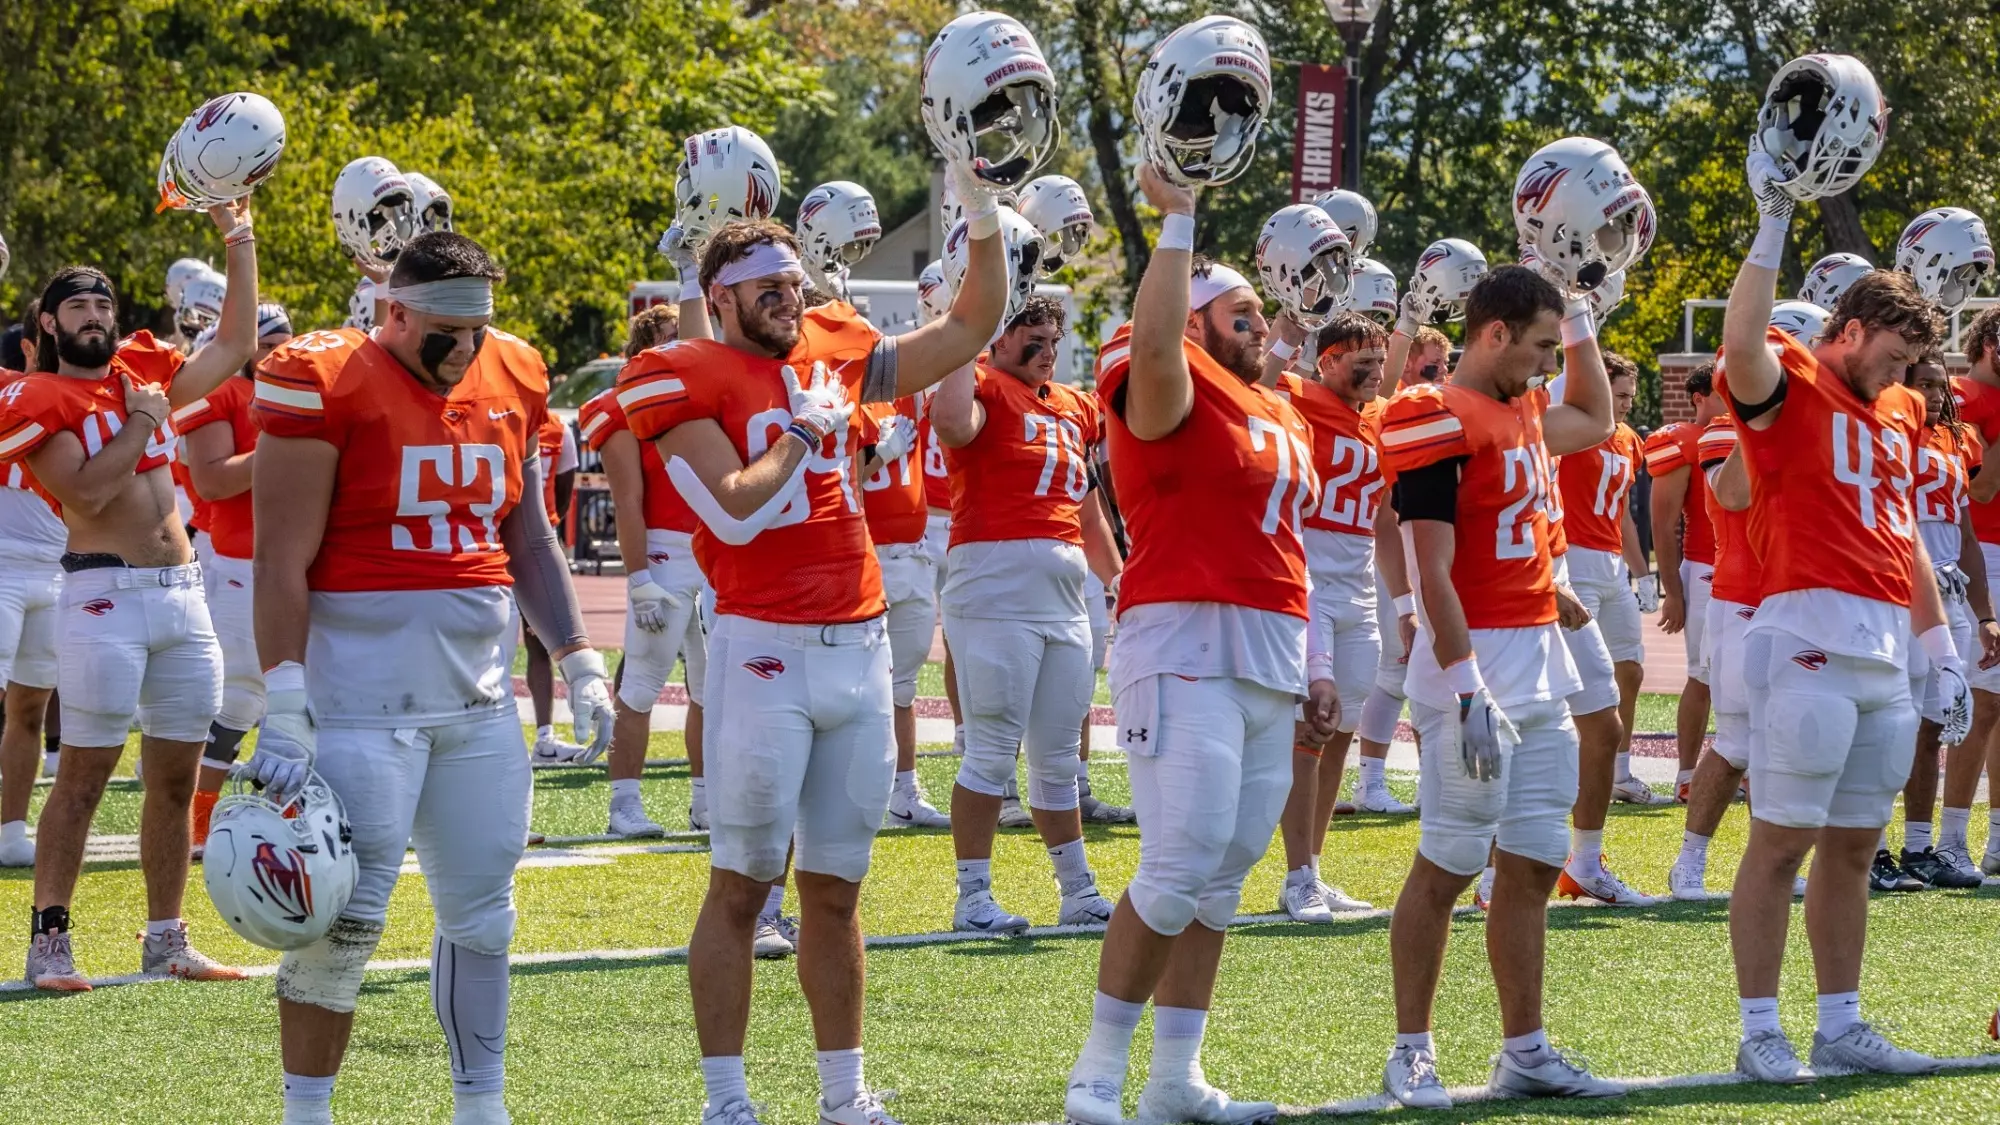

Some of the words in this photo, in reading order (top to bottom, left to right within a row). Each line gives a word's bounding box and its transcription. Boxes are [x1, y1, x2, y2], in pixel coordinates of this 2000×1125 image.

[984, 64, 1016, 88] RIVER
[1017, 61, 1048, 76] HAWKS
[1216, 56, 1247, 69] RIVER
[1301, 91, 1336, 184] HAWKS
[373, 182, 391, 198] RIVER
[1603, 195, 1629, 218] RIVER
[854, 228, 871, 237] RIVER
[1308, 237, 1329, 254] RIVER
[1372, 300, 1388, 308] RIVER
[0, 381, 27, 406] 4
[1023, 412, 1089, 503] 76
[1319, 434, 1386, 530] 22
[1593, 448, 1631, 520] 17
[1832, 411, 1914, 539] 43
[391, 443, 506, 554] 53
